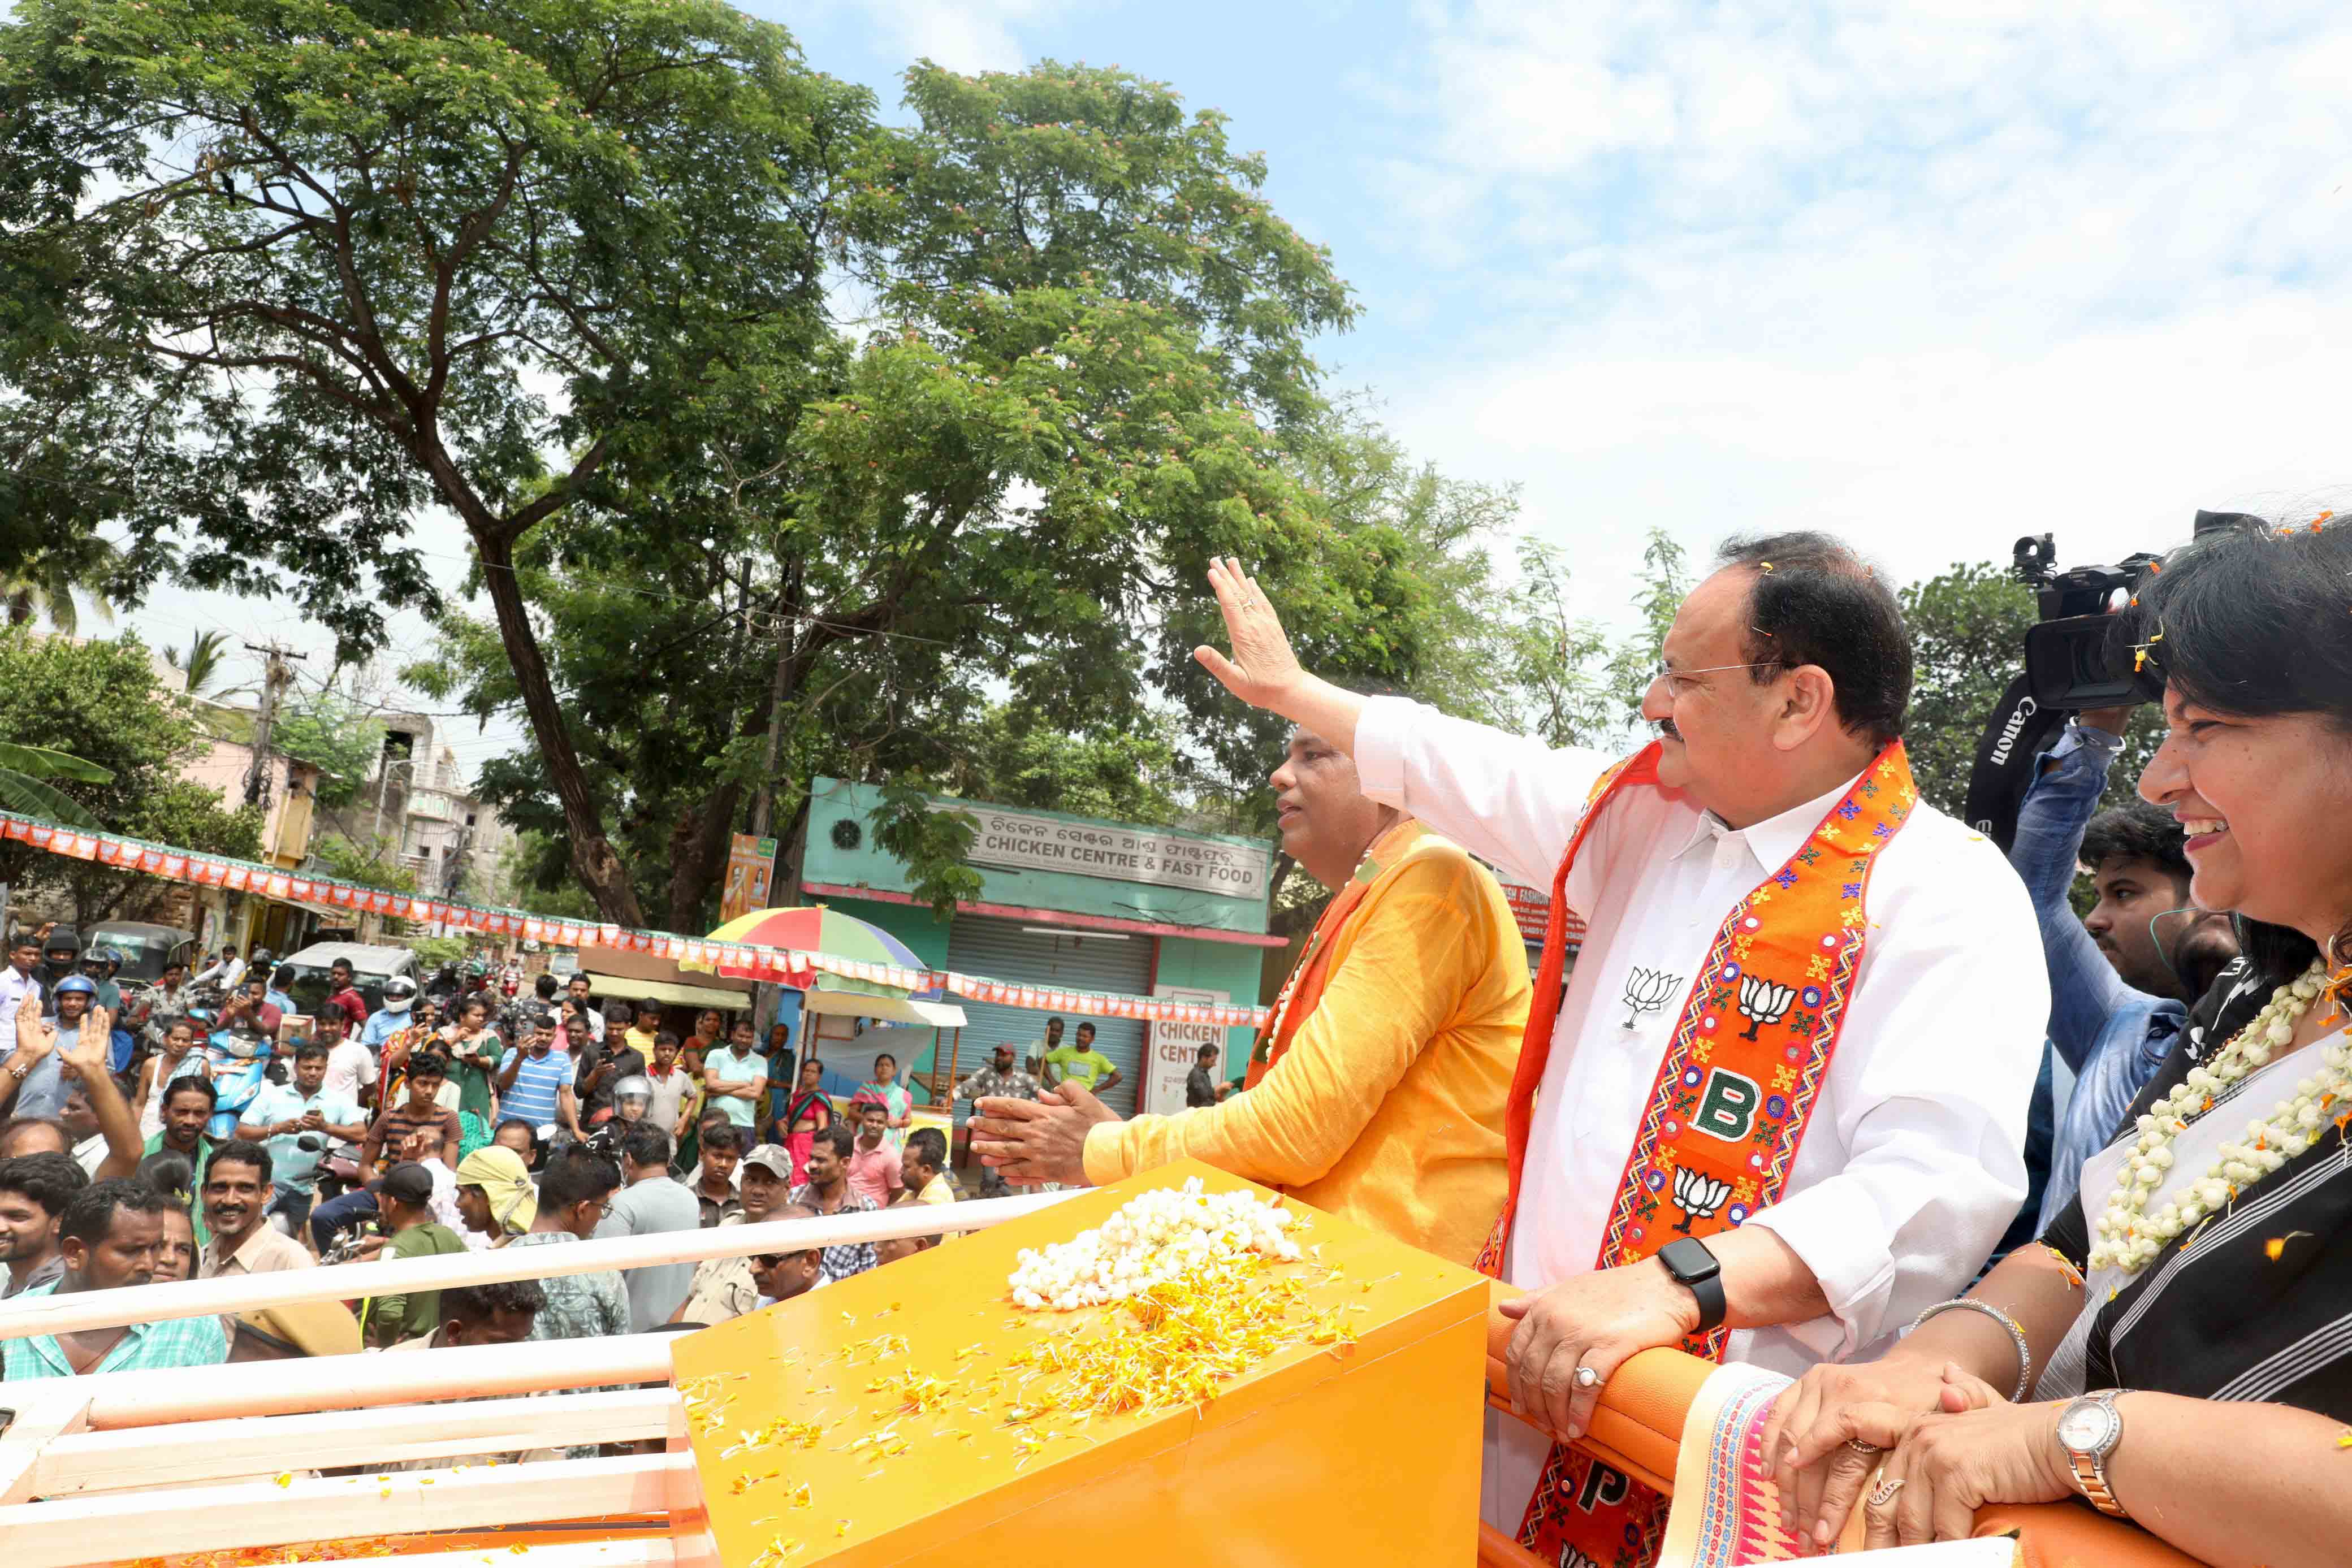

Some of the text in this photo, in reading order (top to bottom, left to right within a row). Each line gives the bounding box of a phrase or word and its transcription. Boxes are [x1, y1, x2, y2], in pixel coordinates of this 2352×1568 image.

[1990, 696, 2037, 766] Canon
[985, 835, 1065, 859] CHICKEN
[1071, 847, 1138, 868] CENTRE
[1144, 856, 1156, 870] &
[1162, 859, 1204, 876] FAST
[1209, 866, 1253, 884] FOOD
[1159, 1021, 1221, 1043] CHICKEN
[1688, 1066, 1762, 1142] B
